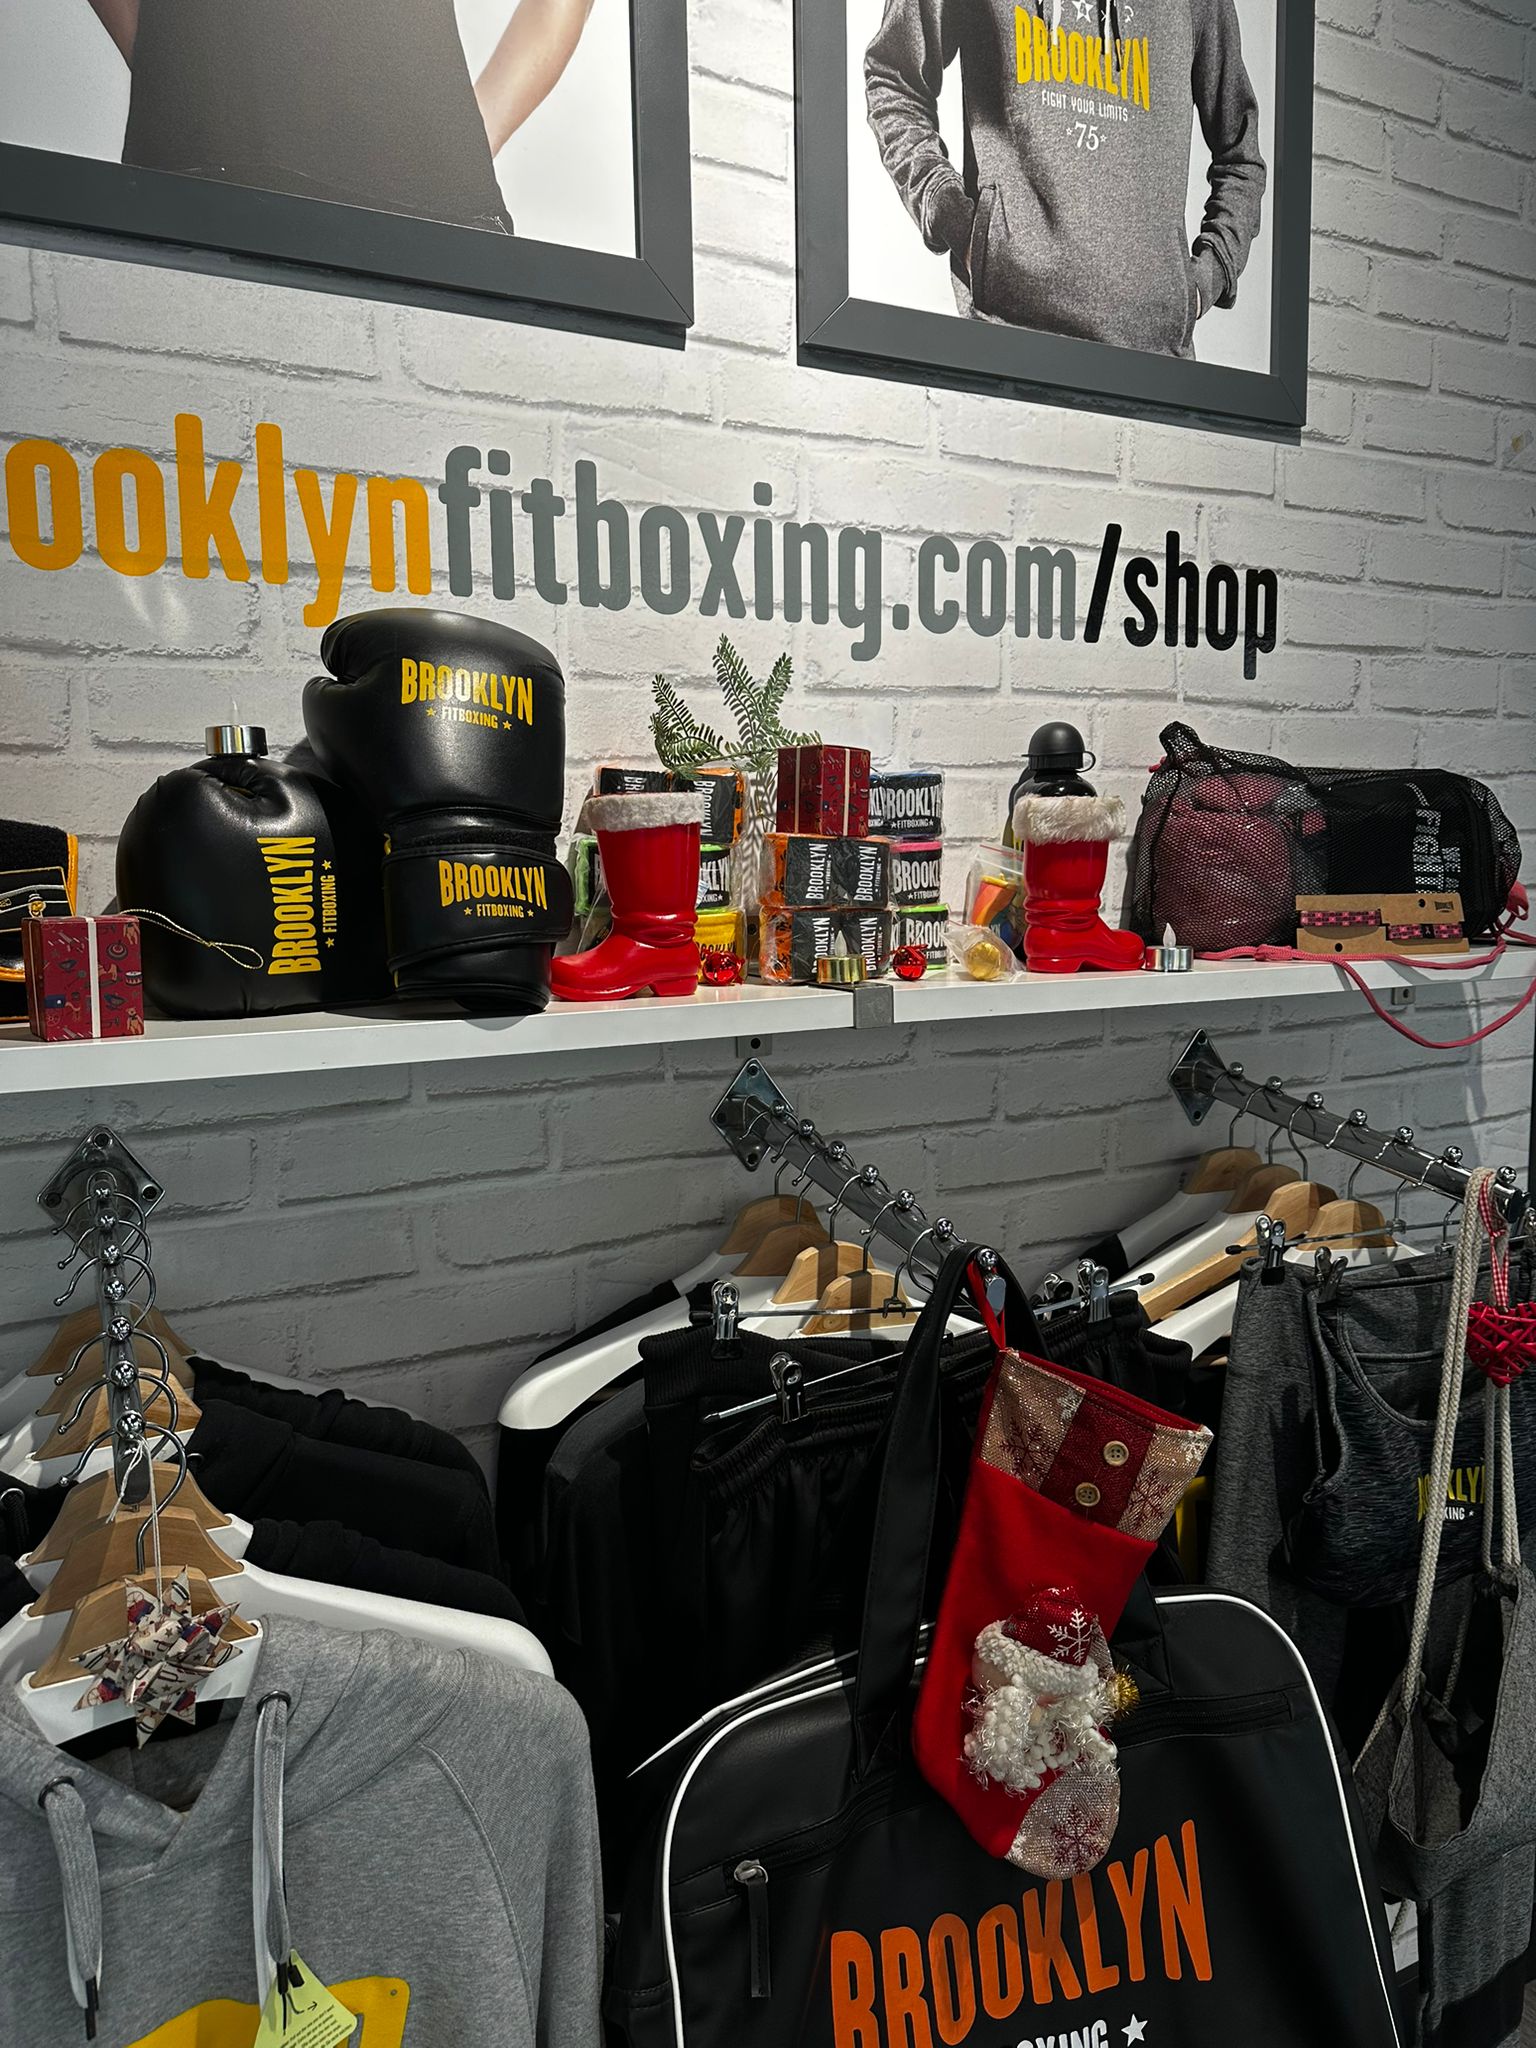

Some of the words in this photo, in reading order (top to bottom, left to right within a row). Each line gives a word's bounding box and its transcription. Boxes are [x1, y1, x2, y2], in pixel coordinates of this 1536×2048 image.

[1015, 5, 1150, 111] BROOKLYN
[1041, 89, 1067, 110] FIGHT
[1071, 95, 1095, 116] YOUR
[1099, 102, 1128, 122] LIMITS
[1075, 121, 1099, 150] 75
[401, 657, 534, 726] BROOKLYN
[441, 706, 498, 729] FITBOXING
[885, 782, 942, 820] ROOKLYN
[805, 843, 829, 900] BROOKLYN
[853, 845, 878, 902] BROOKLYN
[892, 859, 941, 894] BROOKL
[1413, 809, 1444, 894] FIGHT
[256, 836, 322, 975] BROOKLYN
[320, 874, 337, 933] FITBOXING
[438, 859, 548, 911] BROOKLYN
[476, 903, 525, 918] FITBOXING
[859, 917, 879, 971] BROOKLYN
[831, 1819, 1212, 2048] BROOKLYN
